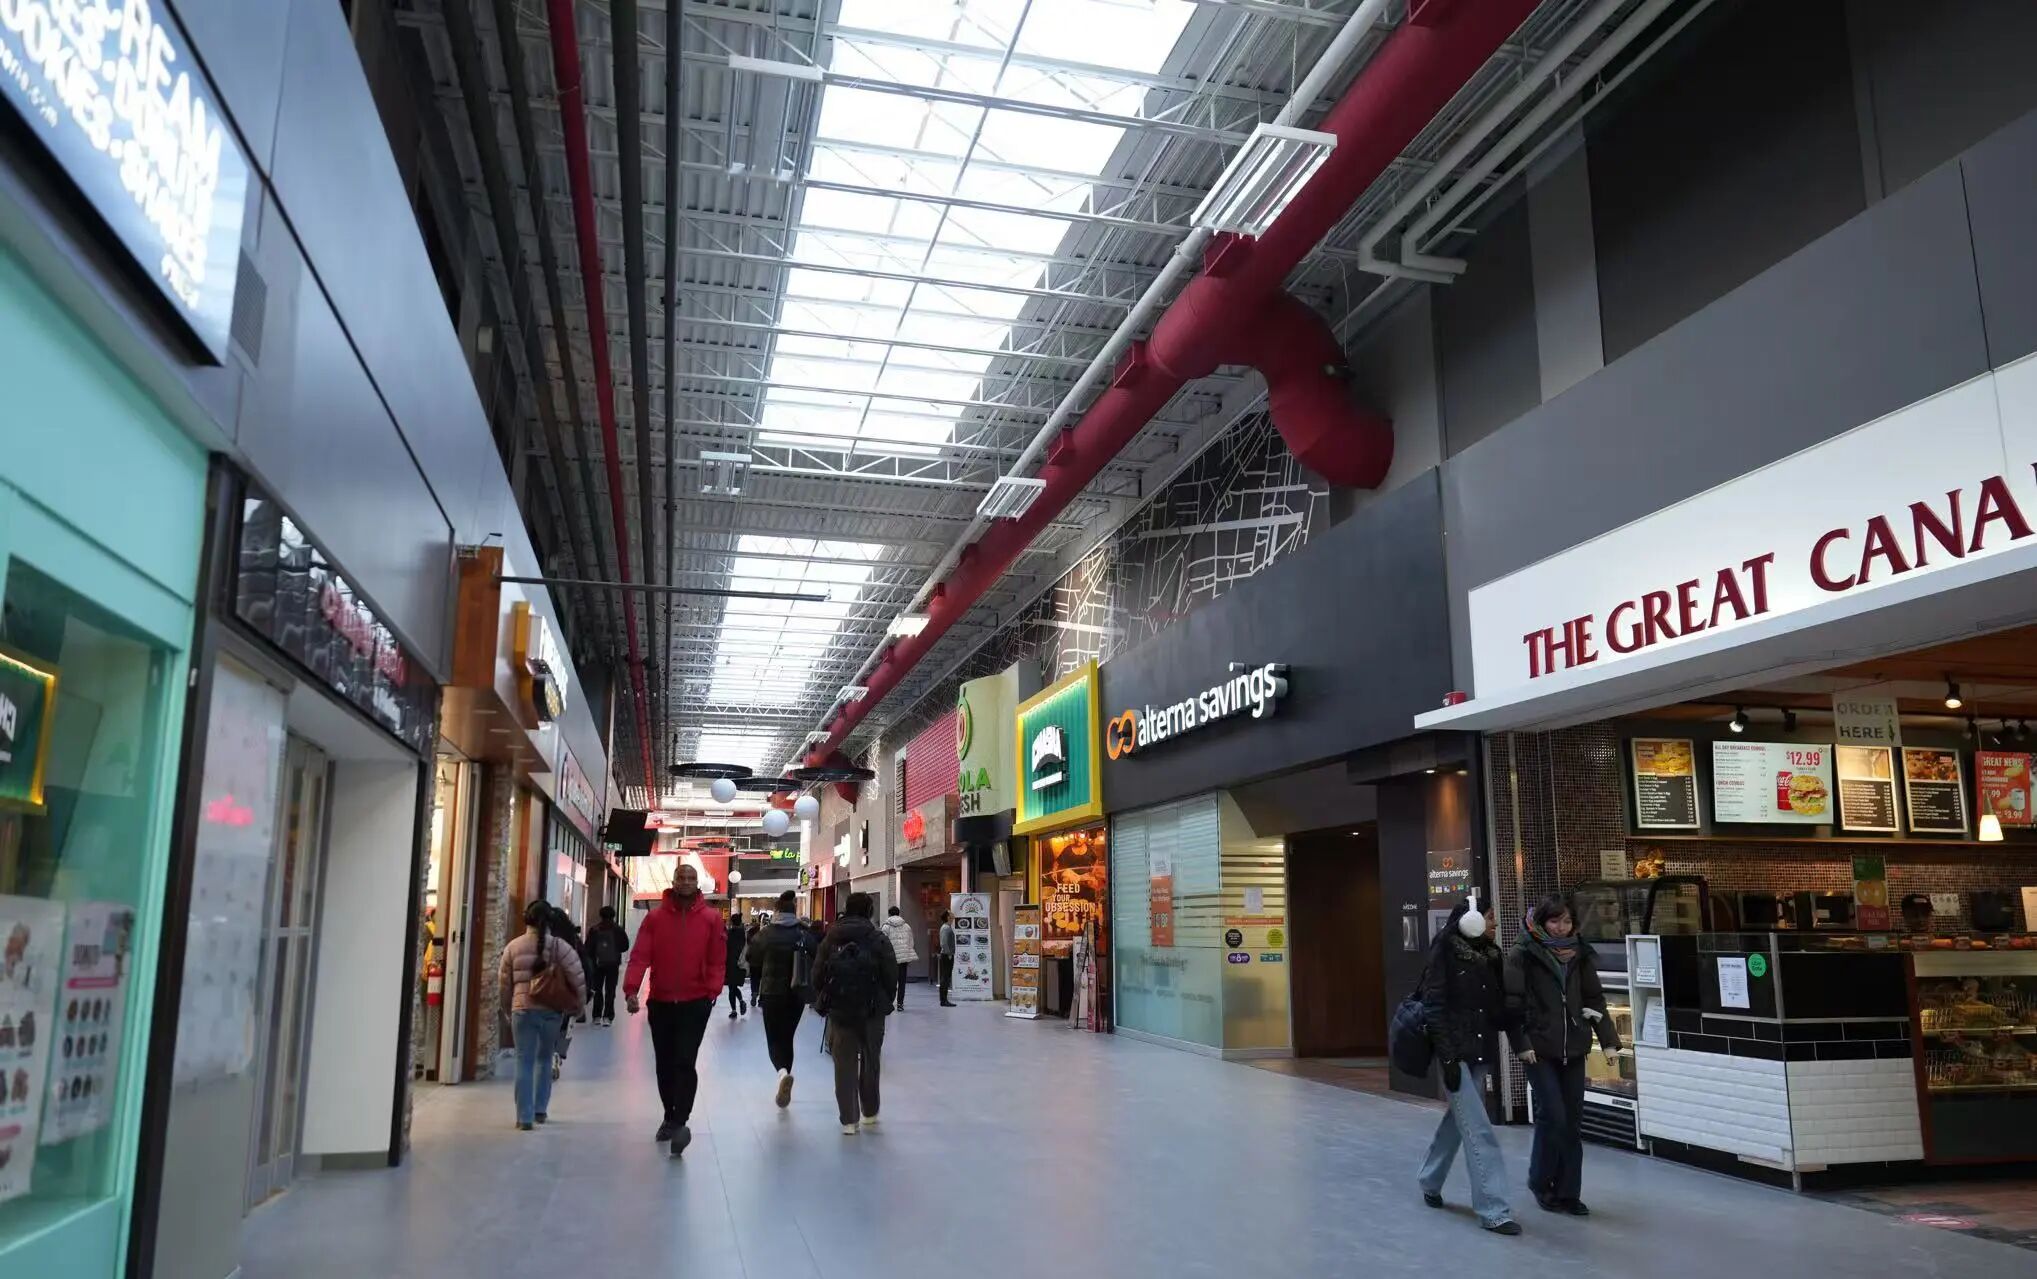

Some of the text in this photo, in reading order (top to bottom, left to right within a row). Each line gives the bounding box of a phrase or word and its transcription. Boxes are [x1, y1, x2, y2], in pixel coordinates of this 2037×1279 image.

[1522, 460, 2037, 680] THE GREAT CANA
[1137, 661, 1278, 748] alterna savings
[1839, 725, 1884, 739] HERE
[1786, 751, 1821, 766] $12.99
[1429, 867, 1469, 879] alterna savings
[1057, 883, 1080, 894] FEED
[1052, 894, 1070, 902] YOUR
[1045, 902, 1096, 913] OBSESSION
